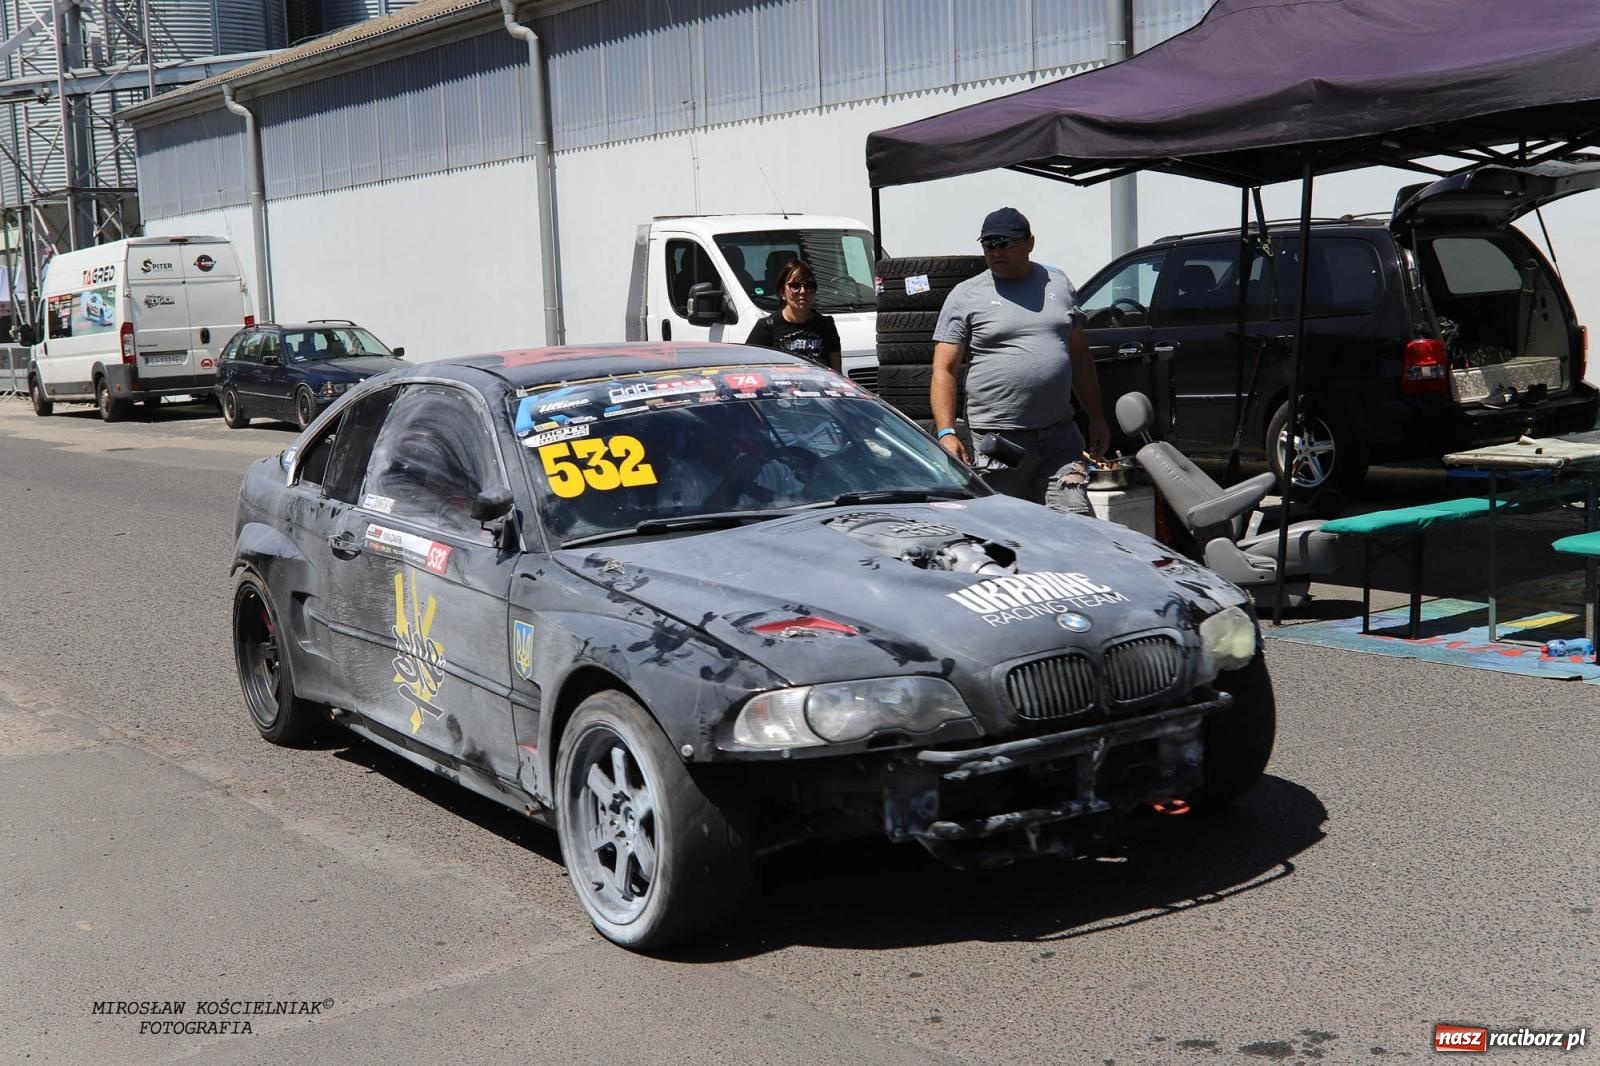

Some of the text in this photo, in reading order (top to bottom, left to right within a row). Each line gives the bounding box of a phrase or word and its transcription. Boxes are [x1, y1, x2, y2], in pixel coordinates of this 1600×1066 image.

[82, 265, 116, 285] TAGRED
[141, 259, 173, 274] SPITER
[538, 435, 658, 498] 532
[427, 547, 448, 571] 532
[982, 592, 1131, 628] RACING TEAM
